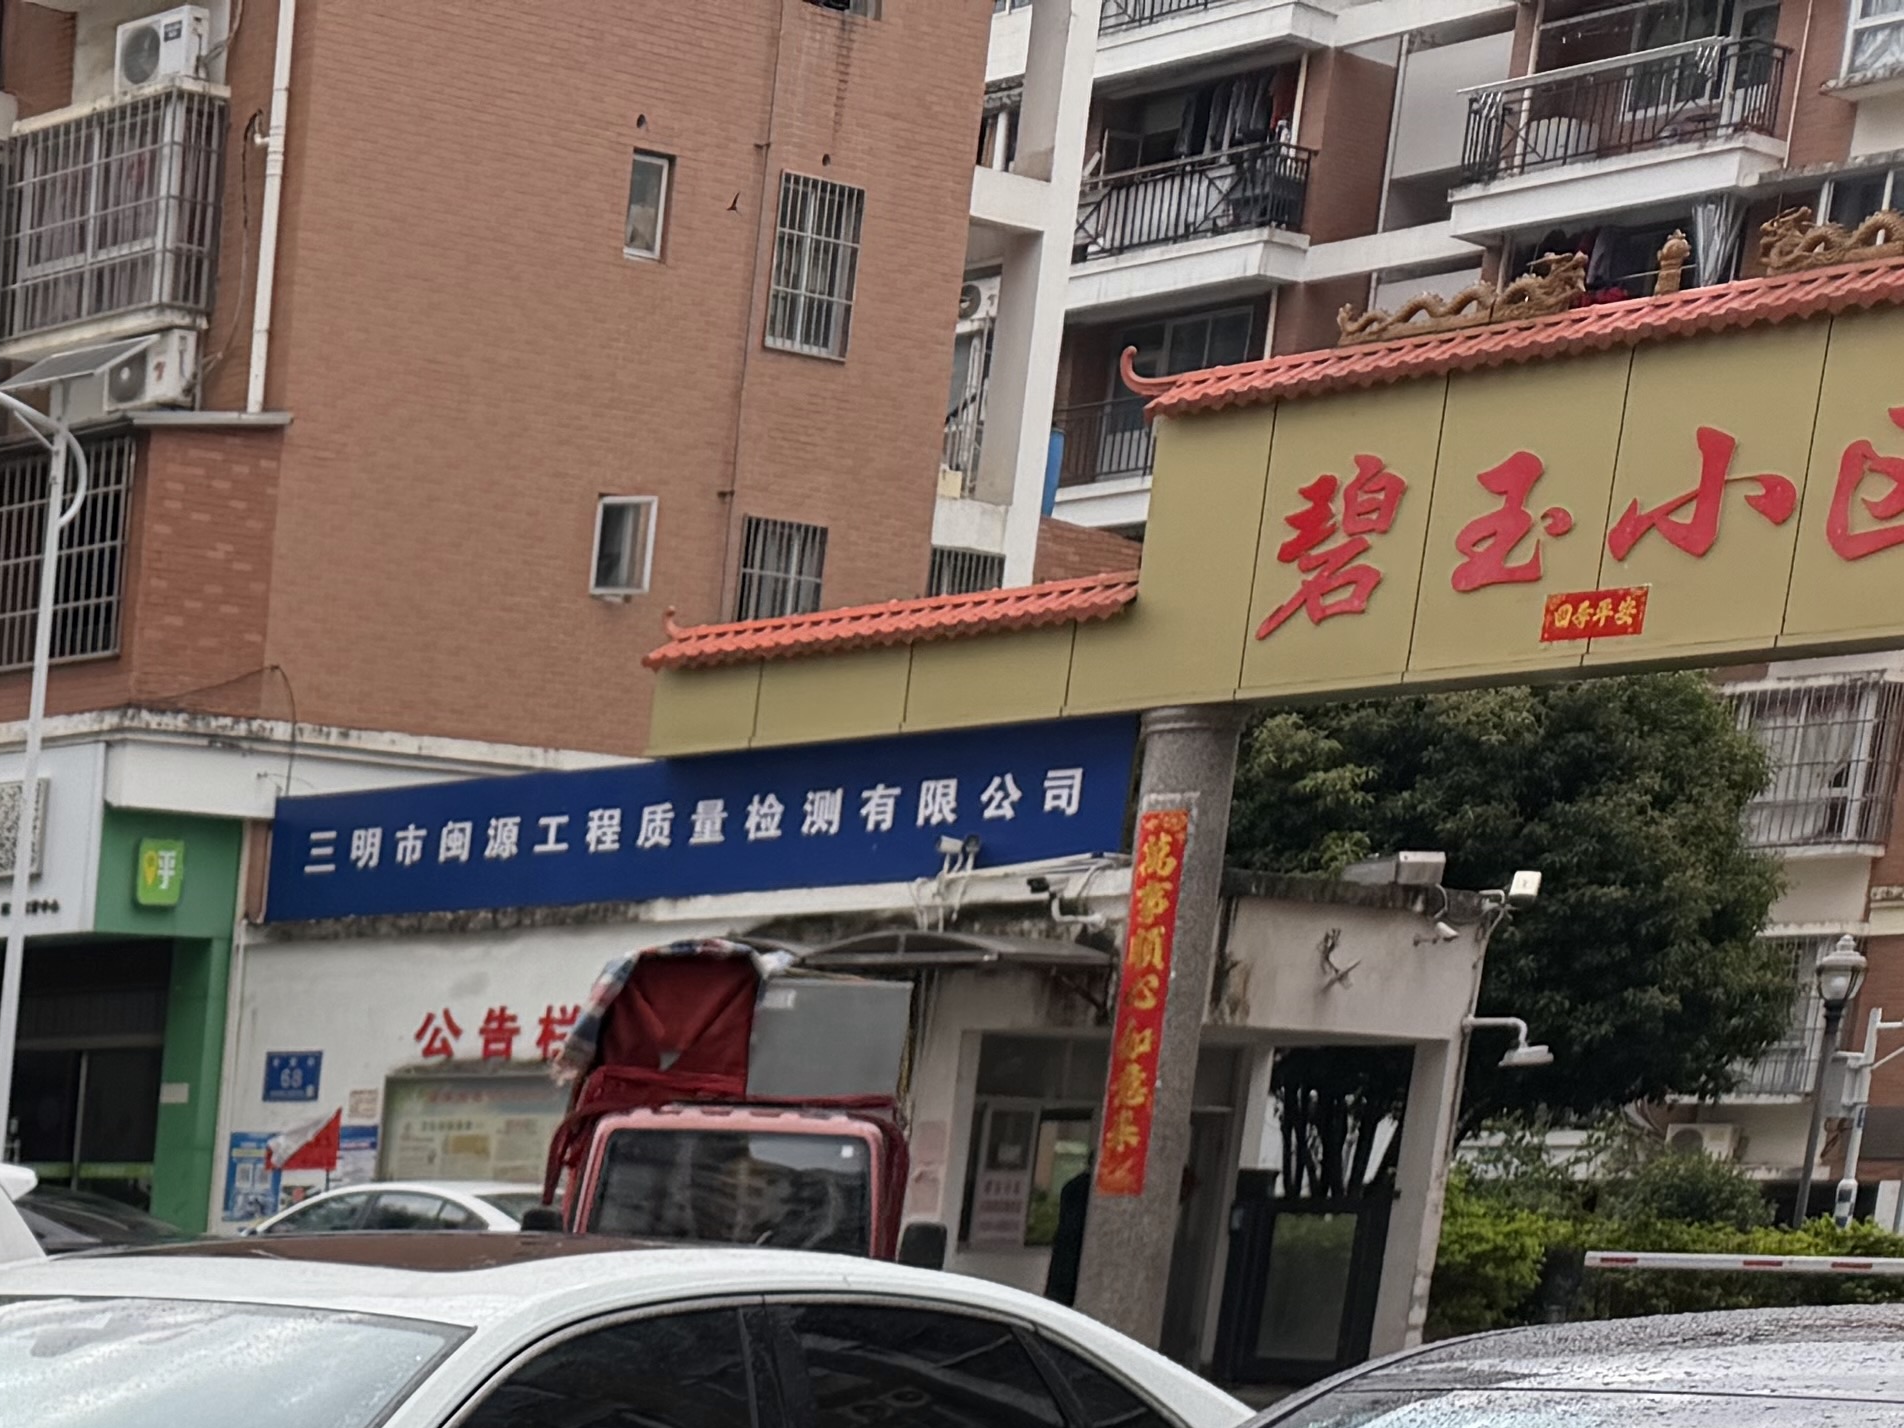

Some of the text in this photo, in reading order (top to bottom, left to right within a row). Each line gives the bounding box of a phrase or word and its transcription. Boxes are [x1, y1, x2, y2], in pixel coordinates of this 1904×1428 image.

[1553, 595, 1638, 629] 四季平安
[303, 766, 1084, 874] 三明市闽源工程质量检测有限公司
[414, 1004, 582, 1060] 公告栏
